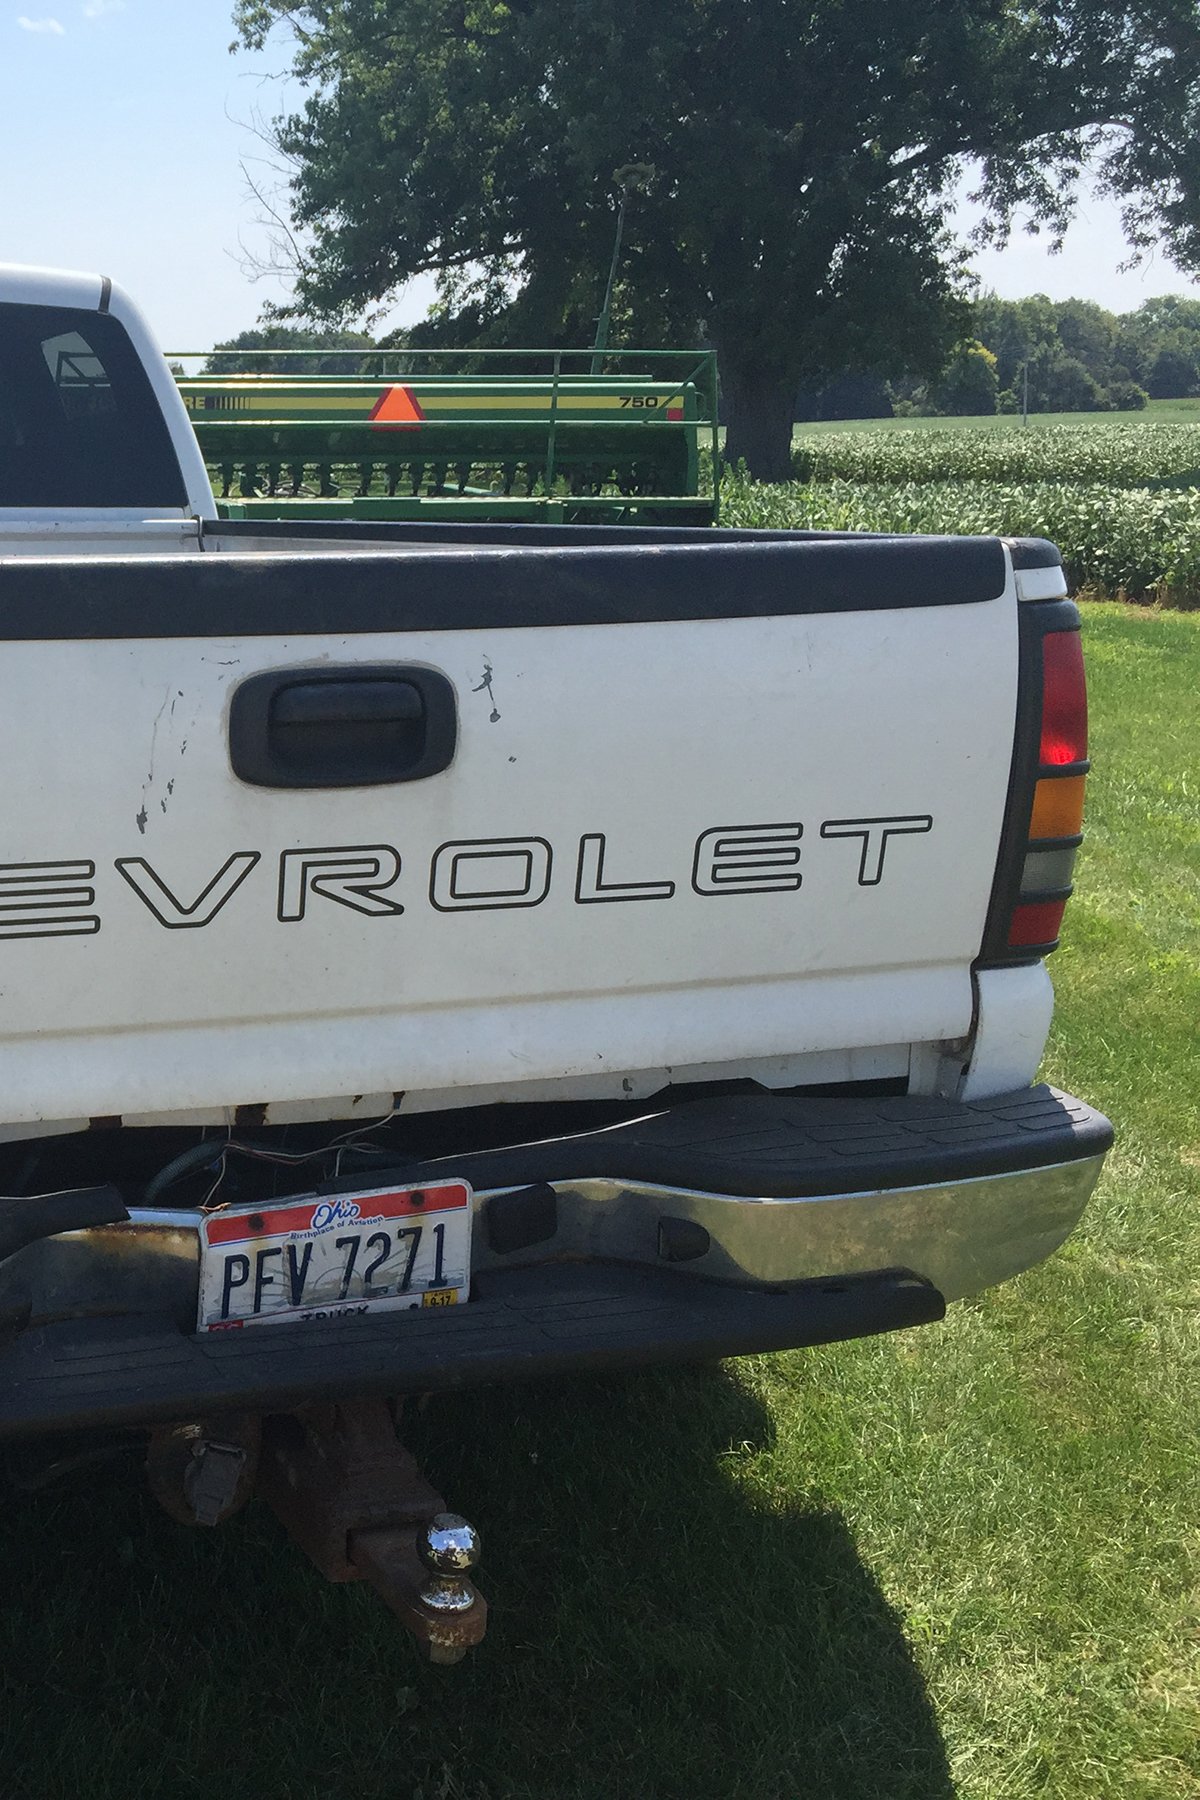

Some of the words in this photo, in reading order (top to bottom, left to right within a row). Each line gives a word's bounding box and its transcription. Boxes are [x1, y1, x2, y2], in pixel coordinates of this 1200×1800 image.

[619, 397, 658, 408] 750
[313, 1200, 360, 1229] Ohio
[290, 1226, 335, 1240] Birthplace
[347, 1216, 384, 1226] Aviation
[221, 1242, 313, 1319] PFV
[335, 1223, 448, 1300] 7271
